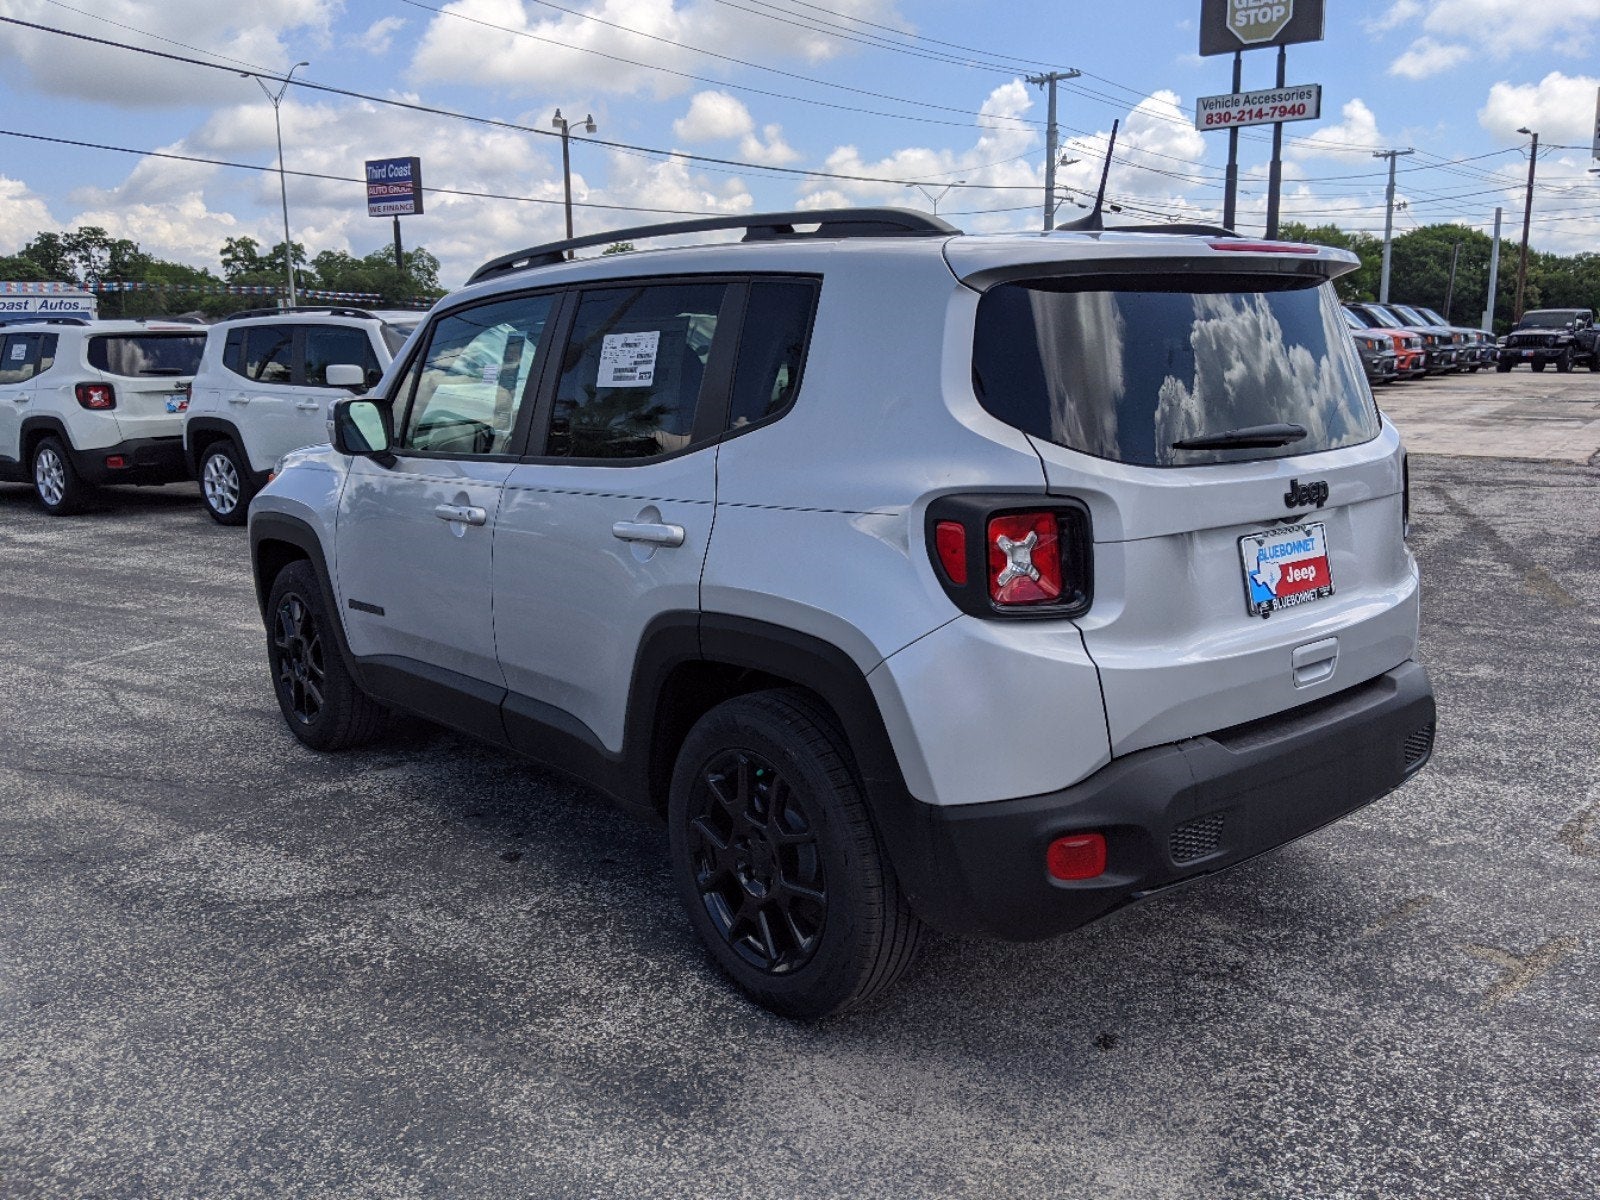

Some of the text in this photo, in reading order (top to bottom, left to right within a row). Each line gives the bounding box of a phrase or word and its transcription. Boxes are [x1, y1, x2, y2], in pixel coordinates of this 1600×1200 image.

[1235, 6, 1286, 27] STOP
[1202, 89, 1312, 111] Vehicle Accessories
[1205, 103, 1307, 125] 830-214-7940
[367, 163, 412, 180] Third Coast
[368, 185, 387, 196] AUTO
[368, 203, 414, 213] WE FINANCE
[0, 299, 79, 311] oast Autos
[1284, 478, 1329, 508] Jeep
[1257, 537, 1315, 561] BLUEBONNET
[1286, 564, 1317, 583] Jeep
[1272, 588, 1318, 611] BLUEBONNET
